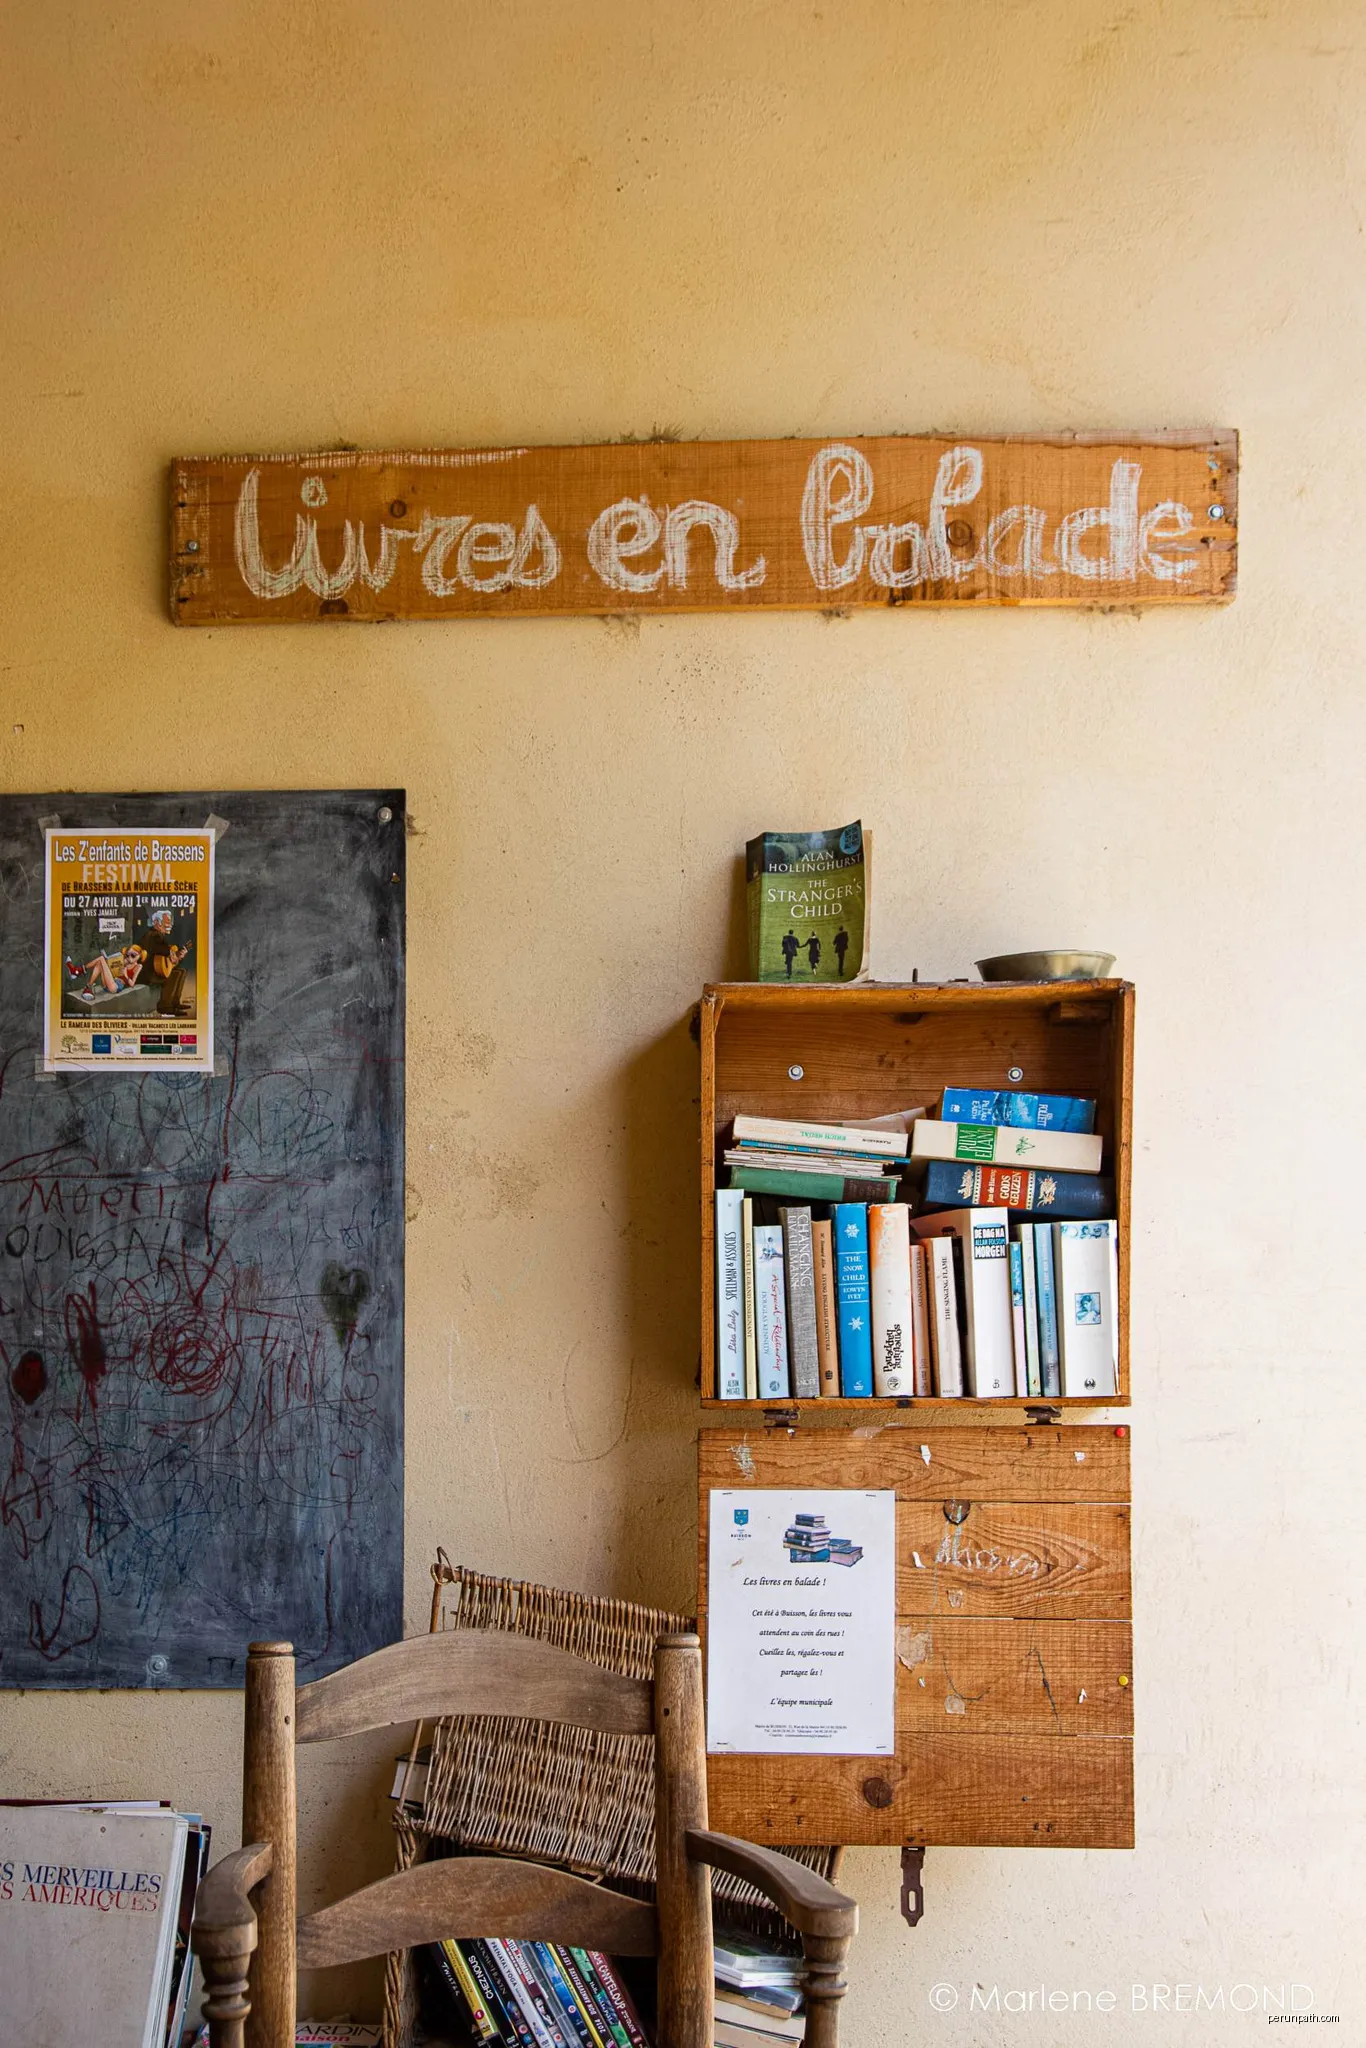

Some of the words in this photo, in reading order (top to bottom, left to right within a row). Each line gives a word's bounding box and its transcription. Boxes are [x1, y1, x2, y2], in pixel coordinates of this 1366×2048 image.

[586, 495, 768, 593] en
[55, 841, 75, 862] Les
[78, 840, 131, 863] Z'enfants
[134, 841, 148, 862] de
[151, 840, 204, 862] Brassens
[801, 851, 834, 862] ALAN
[82, 863, 176, 884] FESTIVAL
[768, 853, 862, 873] HOLLINGHURST
[767, 877, 863, 903] STRANGER'S
[808, 879, 827, 888] THE
[64, 896, 76, 908] DU
[78, 895, 90, 908] 27
[93, 896, 119, 908] AVRIL
[121, 896, 133, 908] AU
[151, 896, 168, 908] MAI
[171, 895, 195, 908] 2024
[790, 903, 843, 919] CHILD
[1037, 1103, 1048, 1127] FOLLETT
[1000, 1175, 1011, 1199] GODS
[797, 1214, 811, 1287] CHANGING
[975, 1245, 1005, 1258] MORGEN
[789, 1234, 800, 1290] ULLMANN
[725, 1268, 737, 1300] SPELLMAN
[842, 1273, 865, 1281] CHILD
[728, 1333, 737, 1354] Lisa
[883, 1329, 896, 1372] happened
[893, 1324, 903, 1369] something
[743, 1576, 758, 1586] Les
[759, 1576, 781, 1586] livres
[795, 1576, 821, 1586] balade
[752, 1609, 763, 1617] Cet
[764, 1609, 773, 1617] été
[781, 1609, 807, 1618] Buisson,
[809, 1609, 818, 1617] les
[819, 1609, 836, 1617] livres
[801, 1629, 814, 1637] coin
[816, 1629, 826, 1637] des
[780, 1669, 808, 1677] partagez
[770, 1698, 797, 1707] L'équipe
[799, 1698, 833, 1707] municipale
[0, 1862, 15, 1881] S
[22, 1864, 162, 1893] MERVEILLES
[491, 1941, 507, 1969] PRENATAL
[506, 1969, 518, 1987] YOGA
[599, 1964, 626, 2010] CANTELOUP
[296, 2025, 381, 2037] ARDIN
